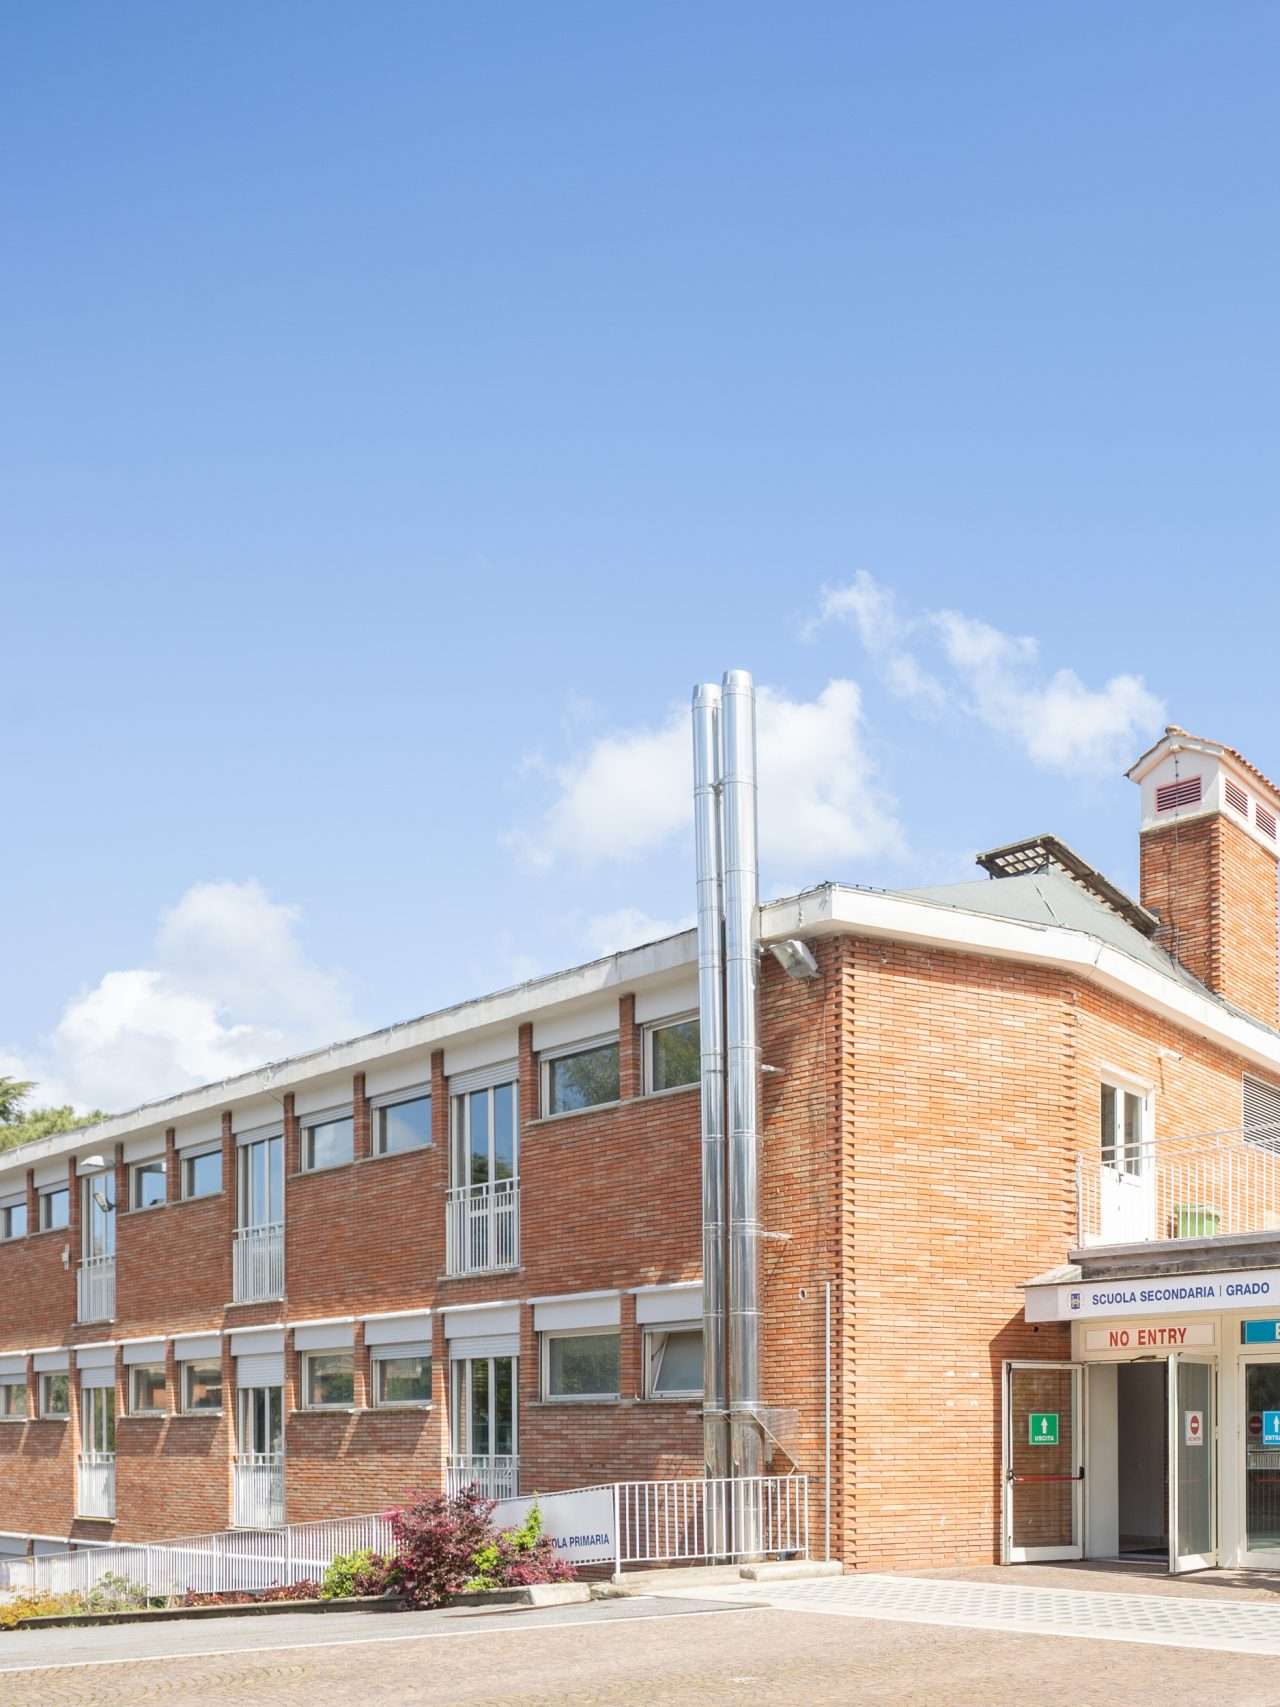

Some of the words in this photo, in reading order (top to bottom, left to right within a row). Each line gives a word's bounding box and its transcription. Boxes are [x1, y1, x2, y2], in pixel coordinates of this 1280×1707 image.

[1092, 1291, 1137, 1305] SCUOLA
[1140, 1285, 1215, 1302] SECONDARIA
[1226, 1282, 1270, 1296] GRADO
[1109, 1330, 1129, 1347] NO
[1138, 1327, 1188, 1346] ENTRY
[569, 1533, 610, 1548] PRIMARIA
